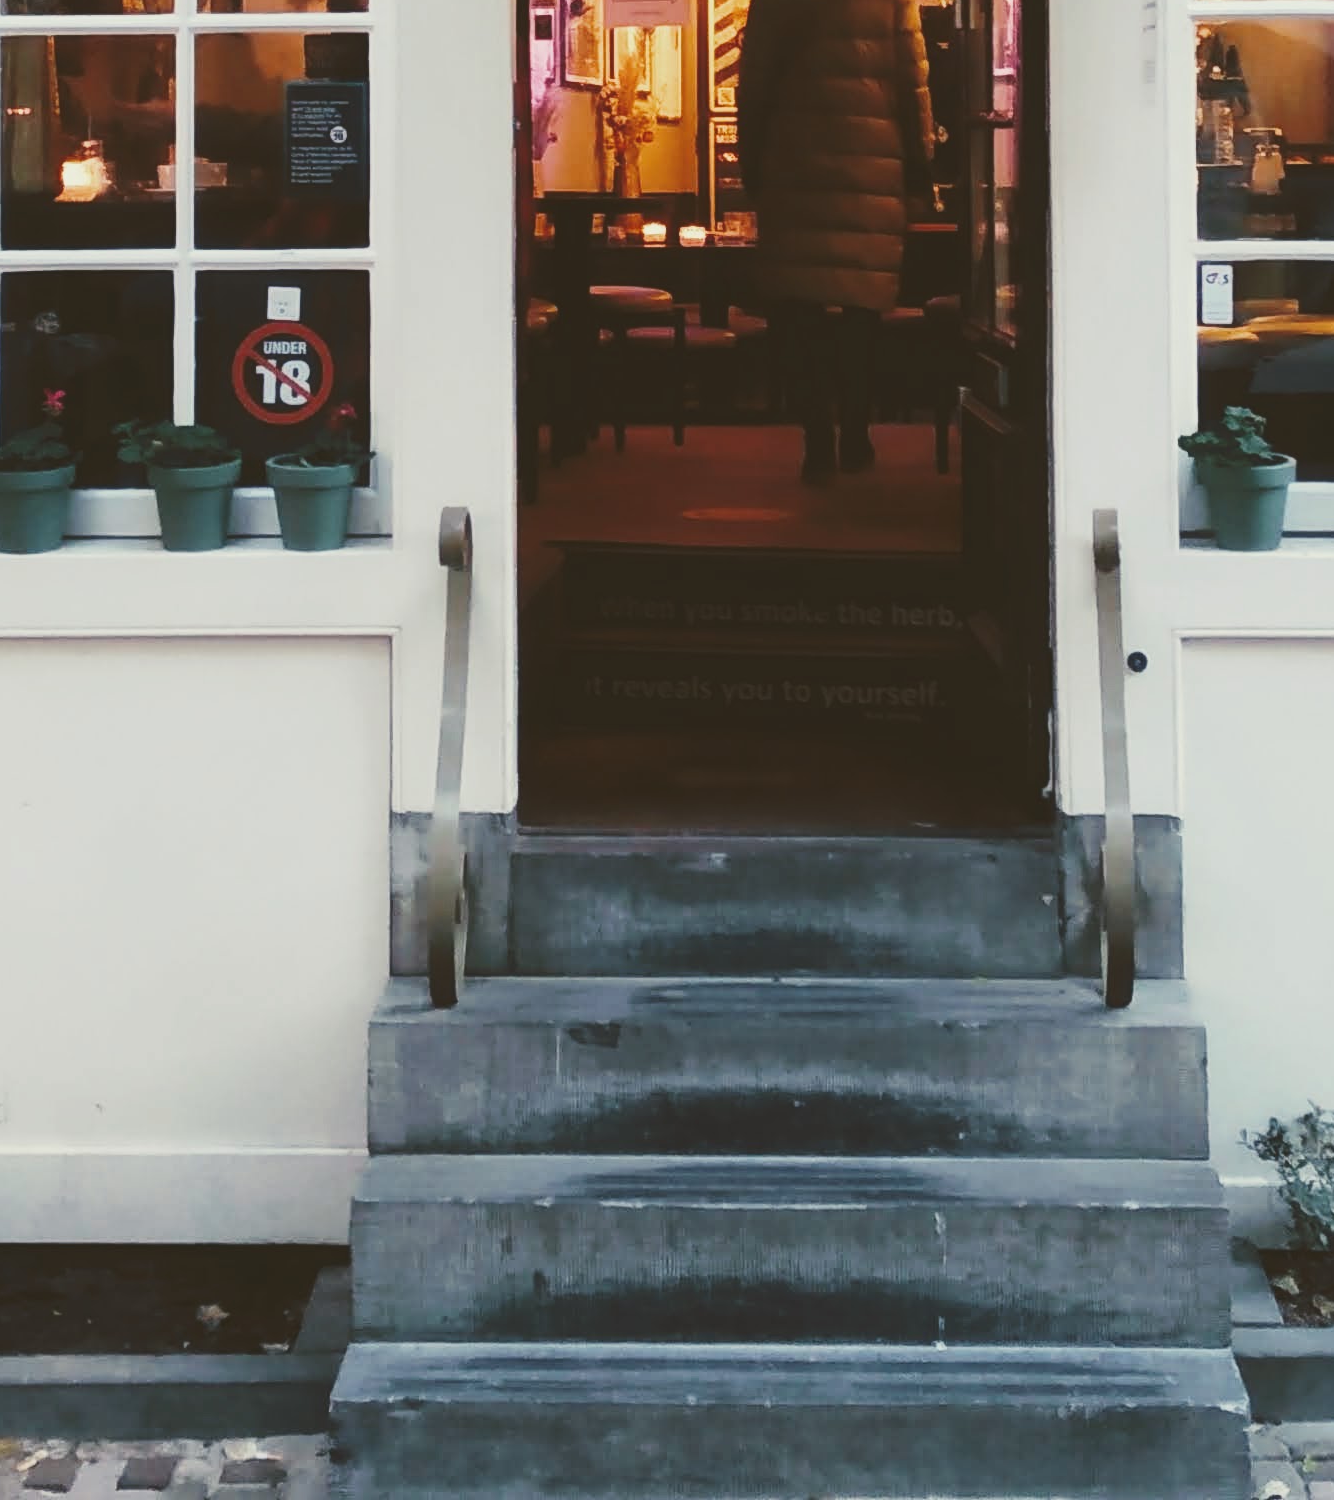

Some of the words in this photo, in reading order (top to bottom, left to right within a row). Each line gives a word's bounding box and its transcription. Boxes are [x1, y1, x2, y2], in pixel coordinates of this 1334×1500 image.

[263, 341, 307, 354] UNDER
[255, 359, 312, 405] 18
[683, 603, 732, 626] you
[837, 602, 883, 625] the
[611, 675, 714, 700] reveals
[721, 682, 773, 707] you
[781, 680, 812, 702] to
[820, 679, 947, 708] yourself.
